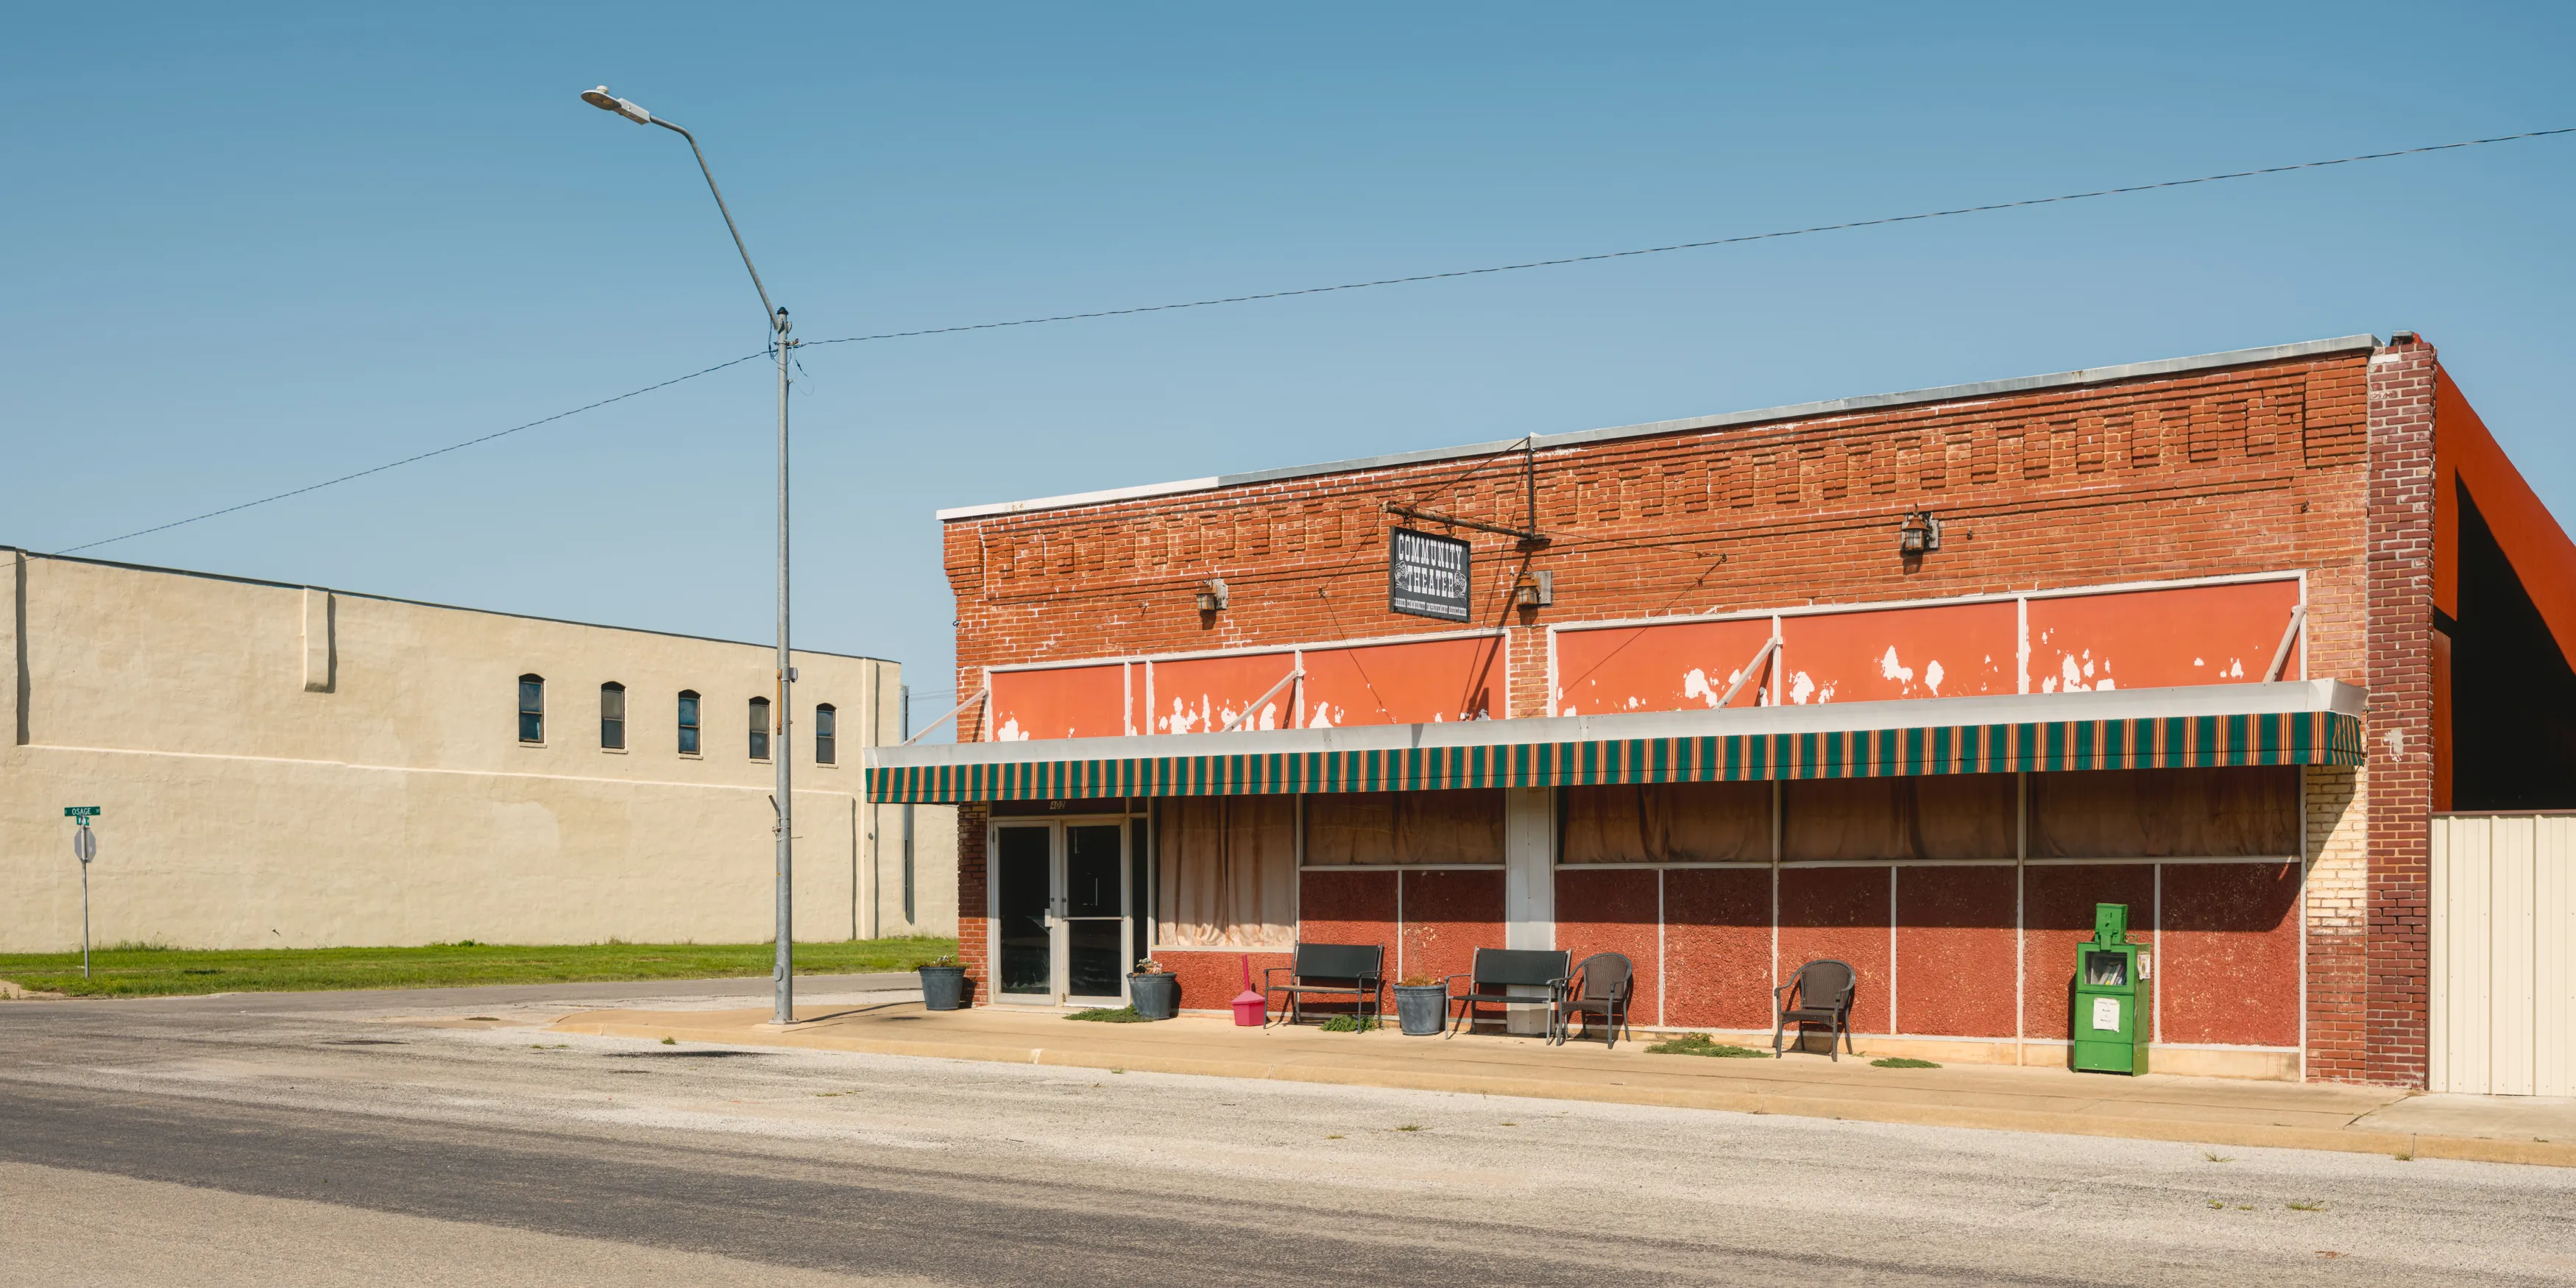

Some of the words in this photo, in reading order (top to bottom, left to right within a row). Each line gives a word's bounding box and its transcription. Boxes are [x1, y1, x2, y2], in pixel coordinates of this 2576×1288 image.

[1398, 533, 1462, 570] COMMUNITY
[1407, 565, 1454, 598] THEATER
[1050, 801, 1066, 810] 402
